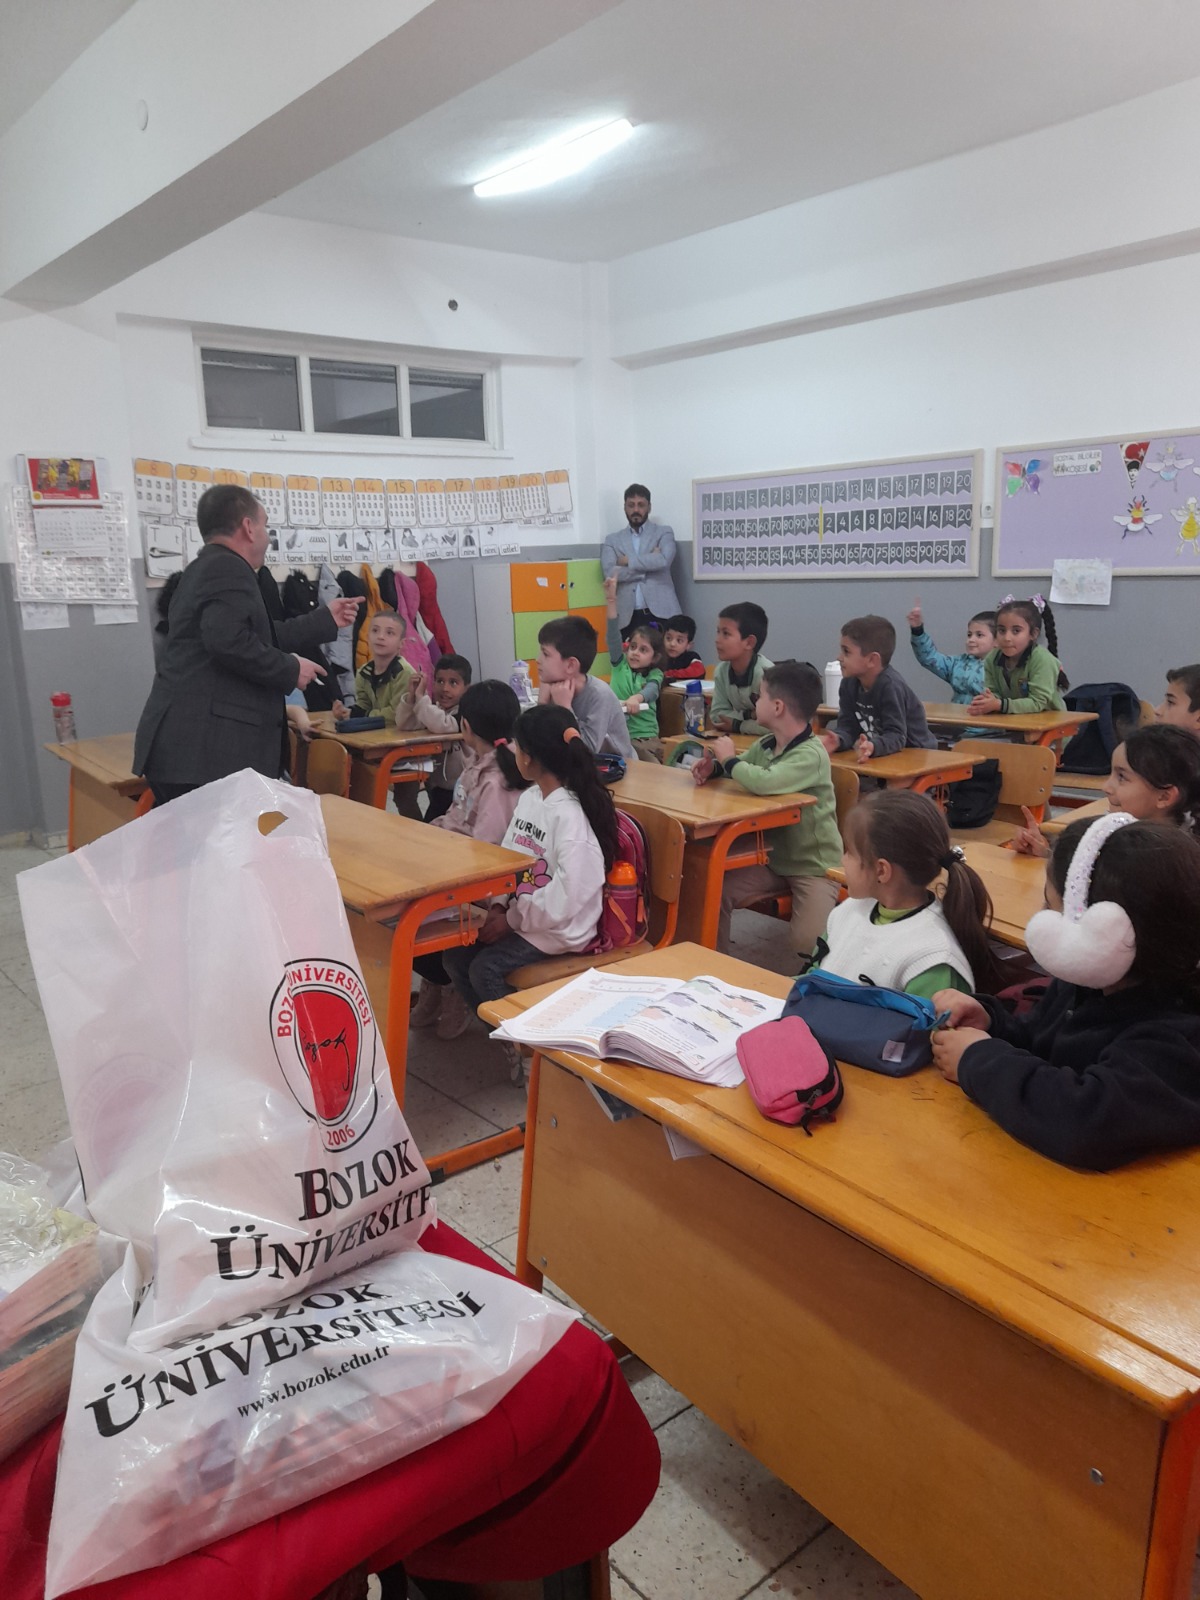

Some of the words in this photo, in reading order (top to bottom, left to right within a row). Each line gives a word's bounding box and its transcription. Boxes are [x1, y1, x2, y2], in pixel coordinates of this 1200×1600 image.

[190, 468, 197, 480] 9
[261, 477, 272, 488] 11
[297, 478, 309, 490] 12
[330, 480, 344, 492] 13
[362, 481, 375, 492] 14
[394, 482, 406, 493] 15
[424, 482, 436, 492] 16
[454, 481, 464, 492] 17
[481, 479, 492, 489] 18
[506, 478, 515, 488] 19
[526, 476, 538, 486] 20
[150, 527, 159, 542] T
[327, 1125, 355, 1146] 2006
[295, 1138, 418, 1221] BOZOK
[84, 1291, 486, 1438] ÜNİVERSİTESİ
[236, 1343, 390, 1418] www.bozok.edu.tr
